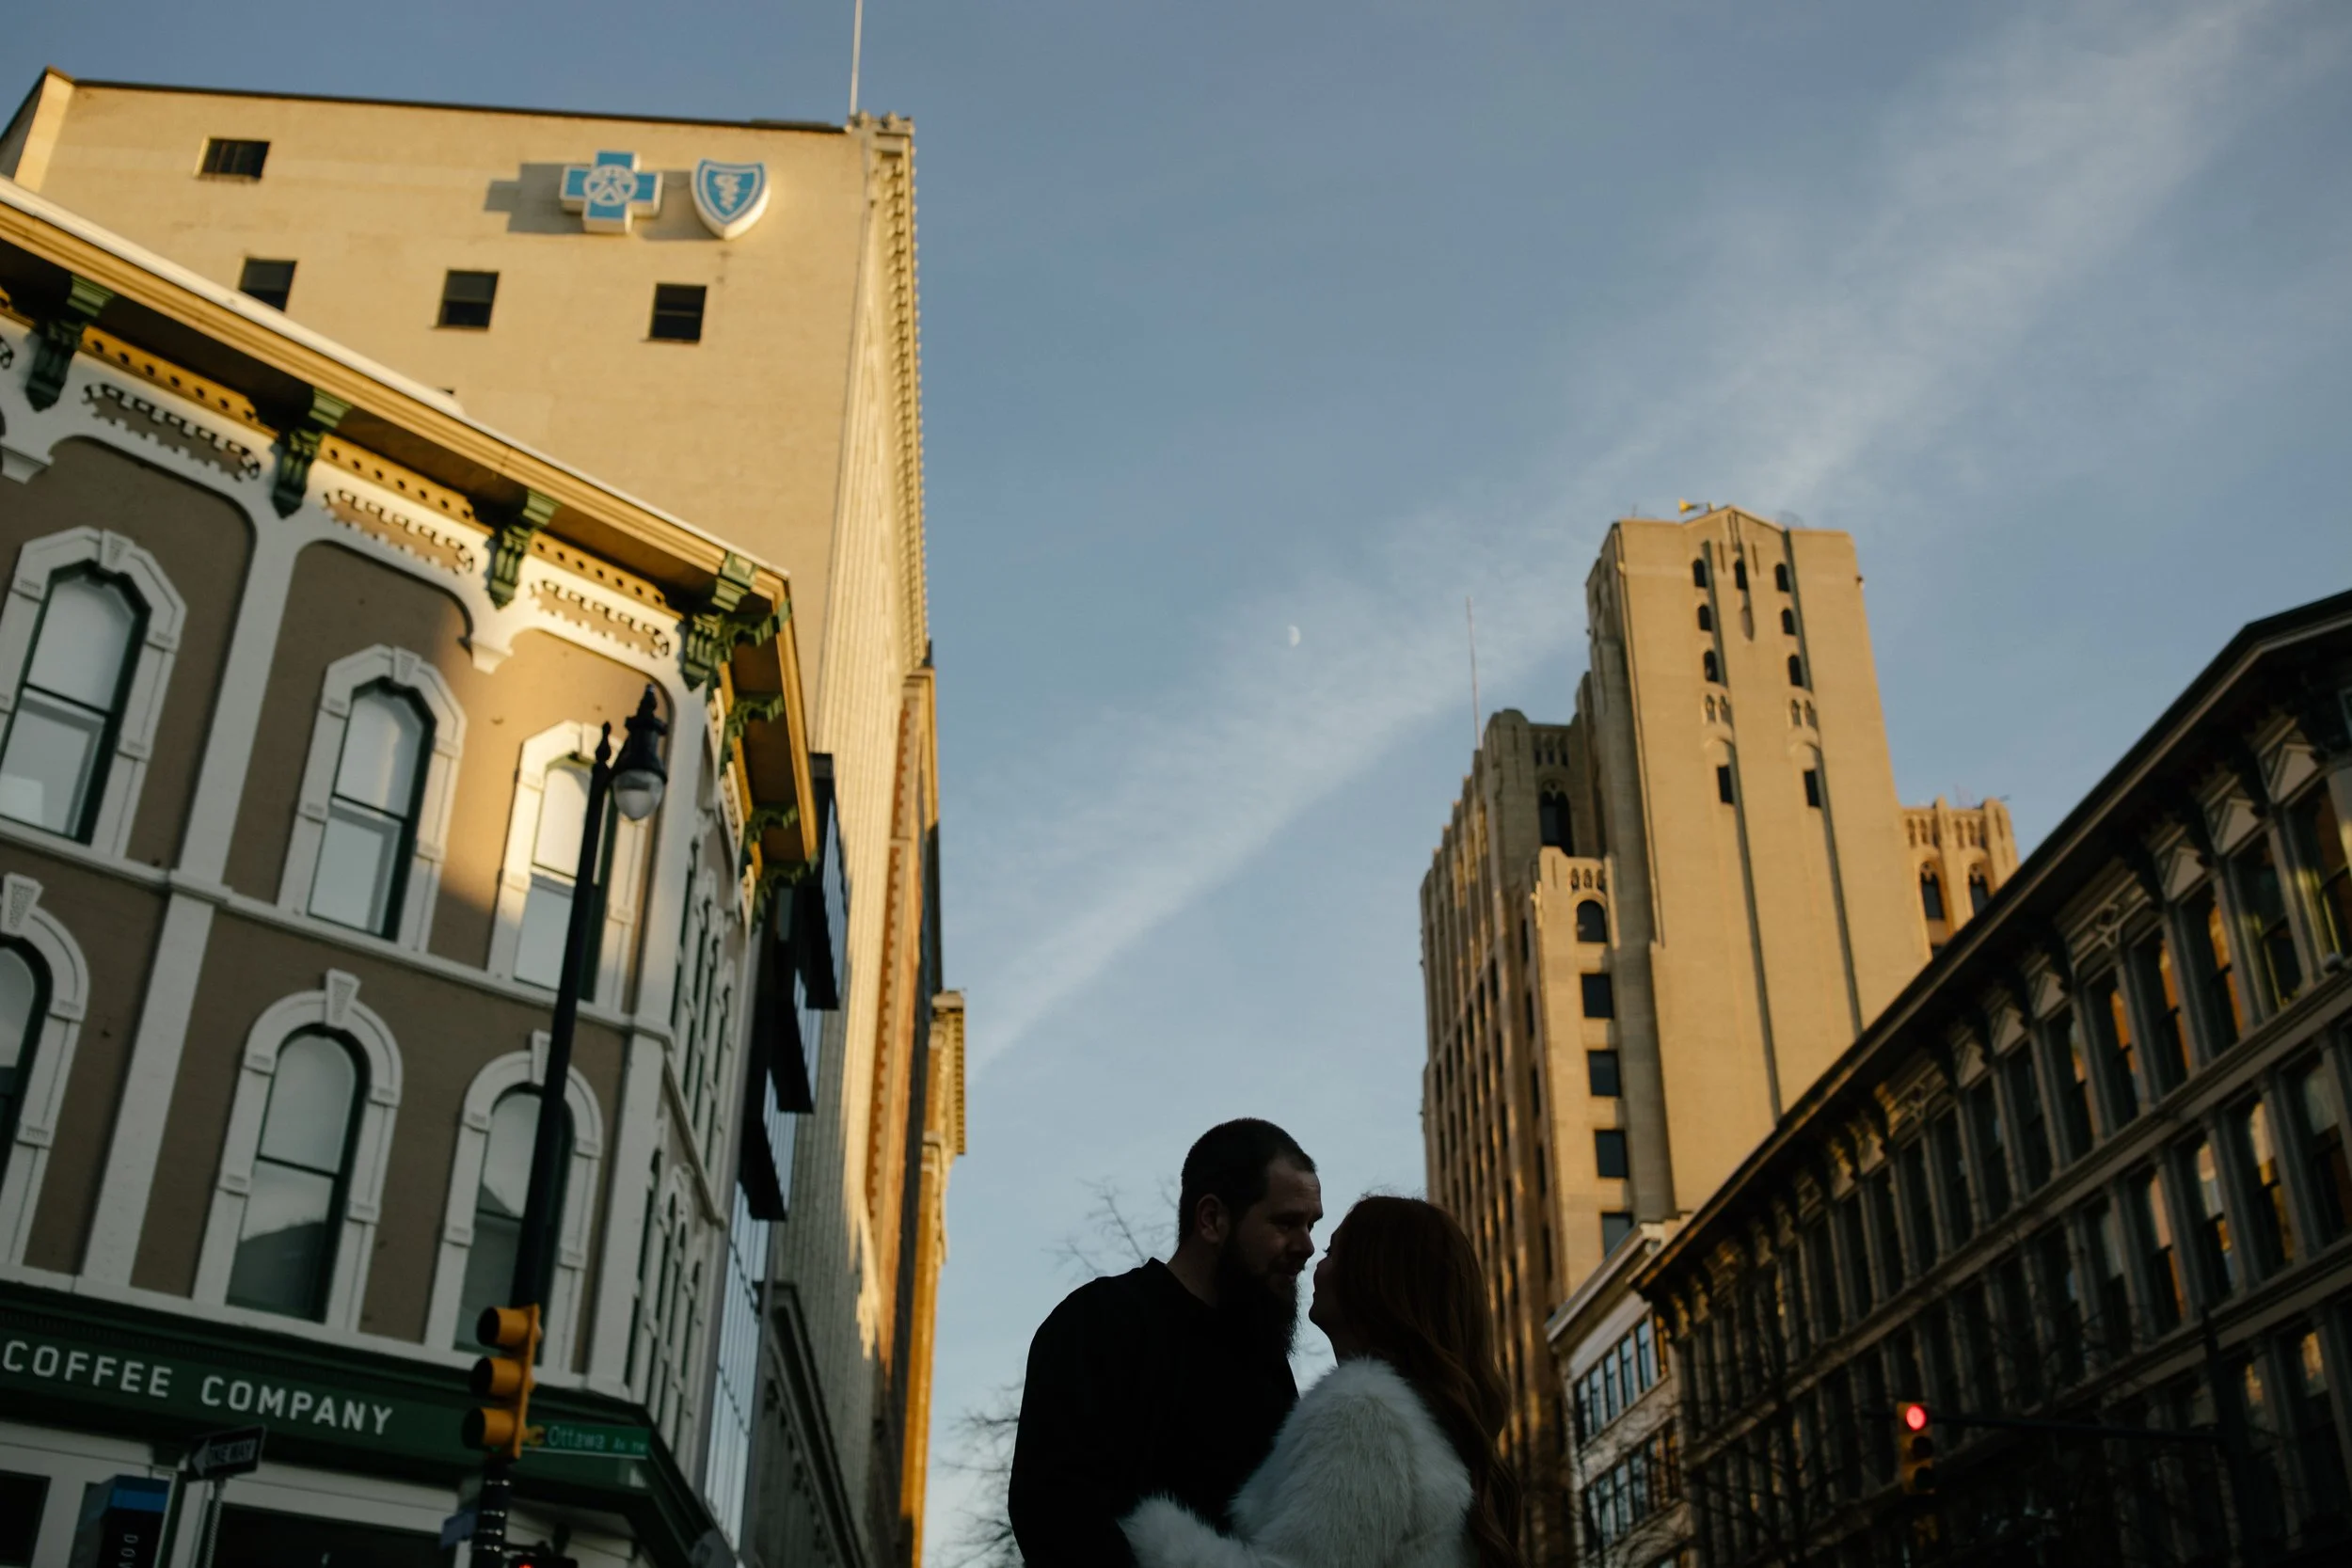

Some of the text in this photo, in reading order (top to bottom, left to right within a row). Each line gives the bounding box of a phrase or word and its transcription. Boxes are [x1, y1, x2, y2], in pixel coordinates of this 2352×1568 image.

[3, 1339, 393, 1435] COFFEE COMPANY
[548, 1425, 606, 1450] Ottawa
